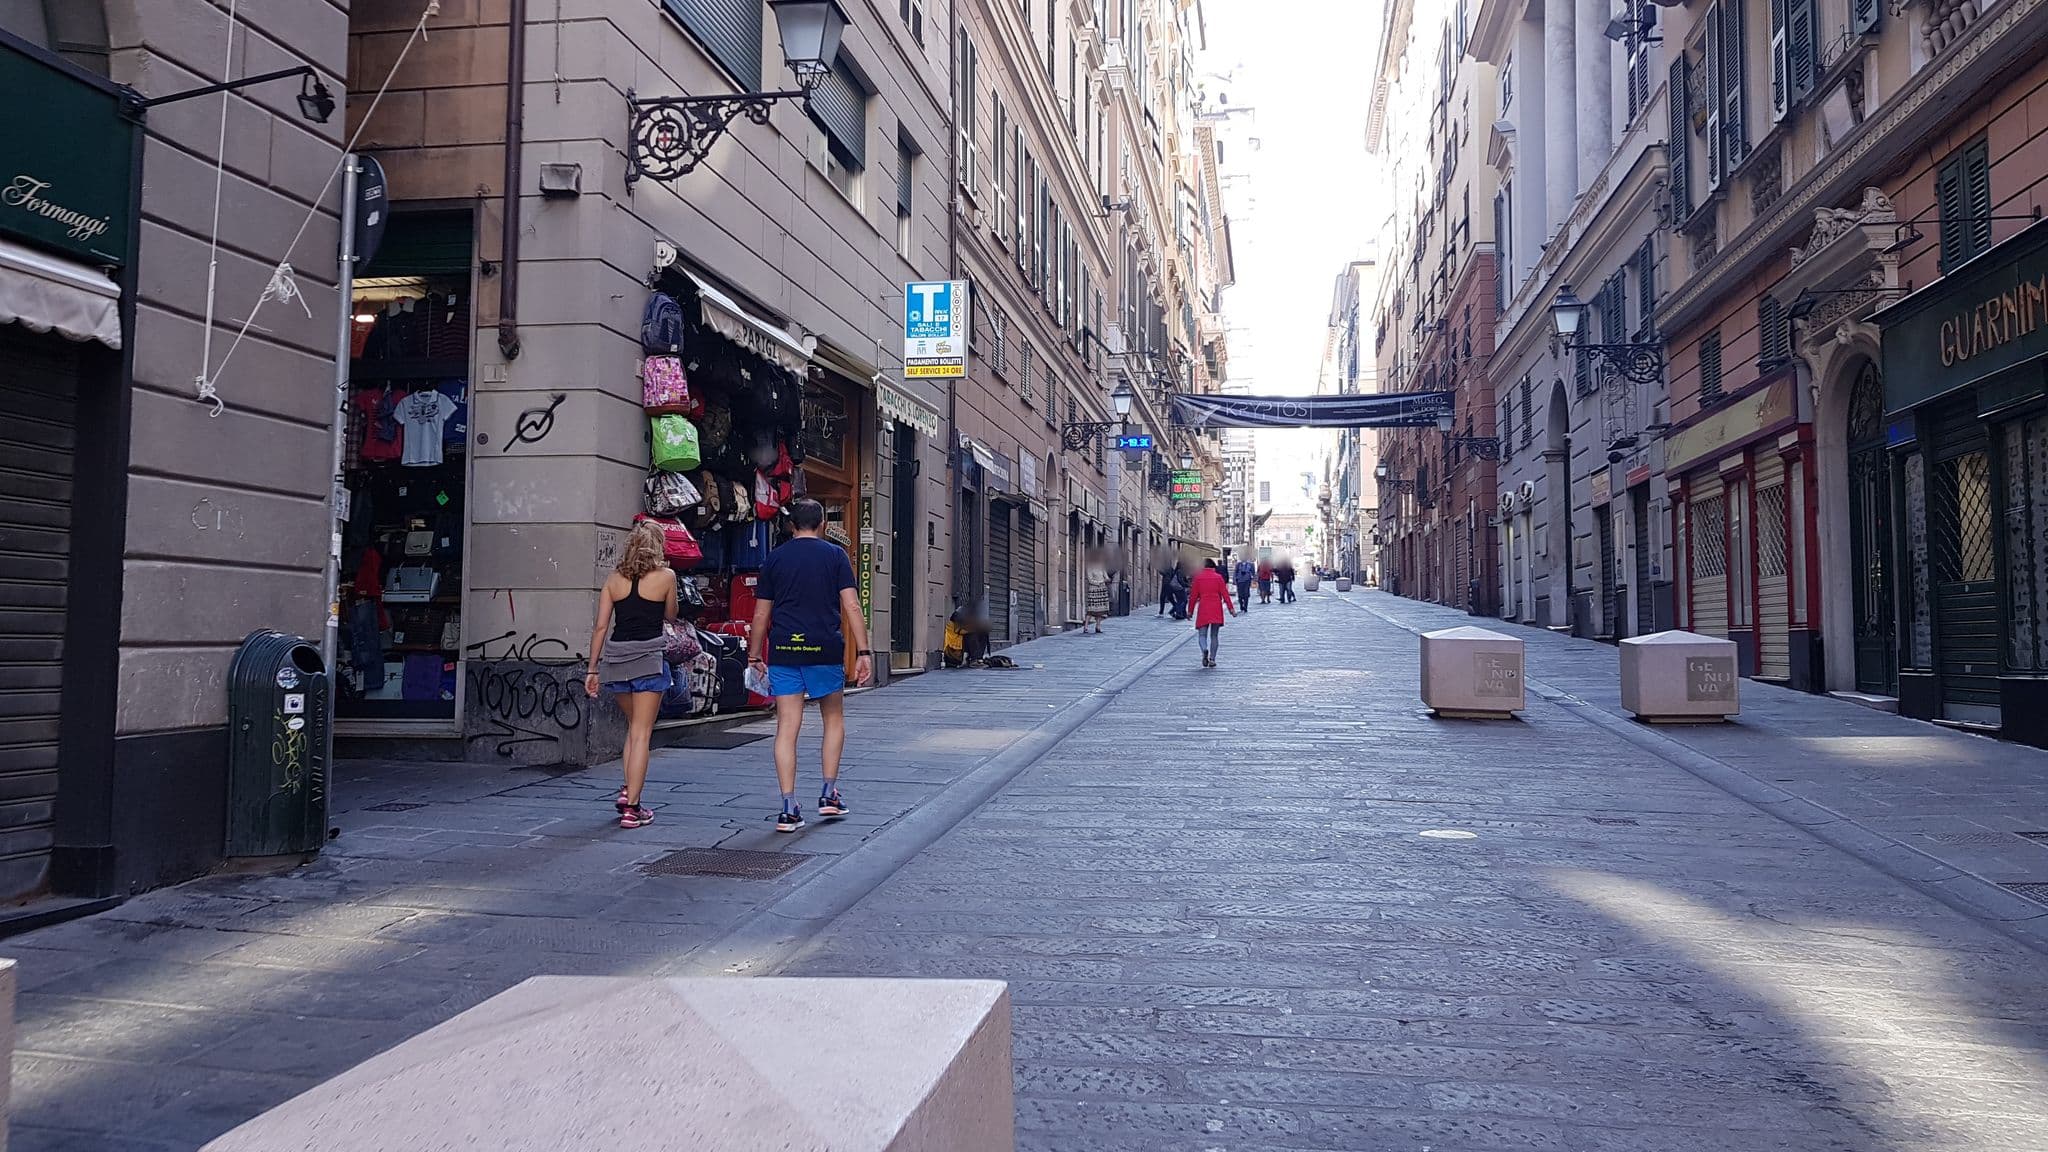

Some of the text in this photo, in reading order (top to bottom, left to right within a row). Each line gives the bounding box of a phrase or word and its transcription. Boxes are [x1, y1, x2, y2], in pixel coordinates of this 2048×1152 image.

[1, 175, 110, 241] Formaggi
[911, 284, 945, 323] T
[907, 357, 962, 366] PAGAMENTO BOLLETTE
[907, 367, 918, 375] SELF
[919, 367, 940, 375] SERVICE
[880, 385, 907, 413] TABACCHI
[1412, 396, 1443, 405] MUSEO
[862, 501, 872, 528] FAX
